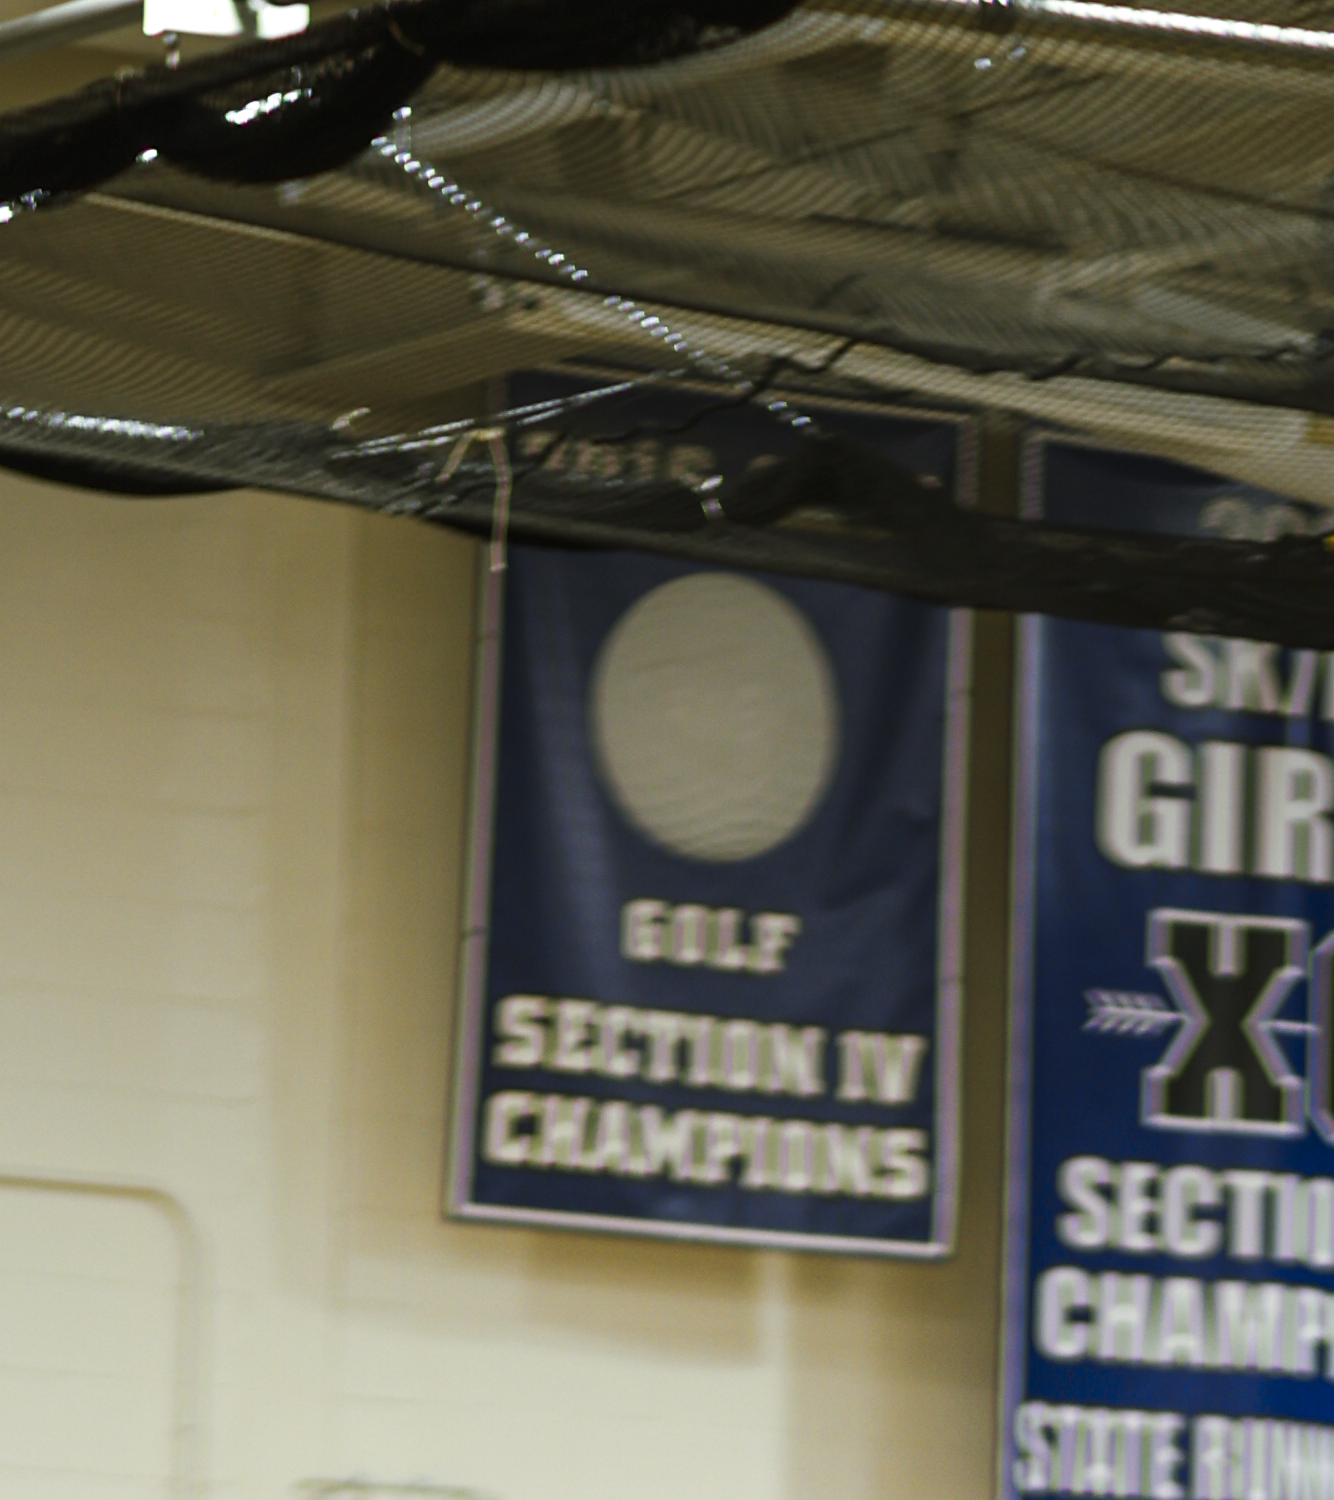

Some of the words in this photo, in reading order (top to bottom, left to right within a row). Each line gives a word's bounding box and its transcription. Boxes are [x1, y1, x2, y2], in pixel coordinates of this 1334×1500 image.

[622, 898, 799, 972] GOLF
[494, 994, 824, 1096] SECTION
[836, 1030, 926, 1103] IV
[484, 1089, 930, 1200] CHAMPIONS
